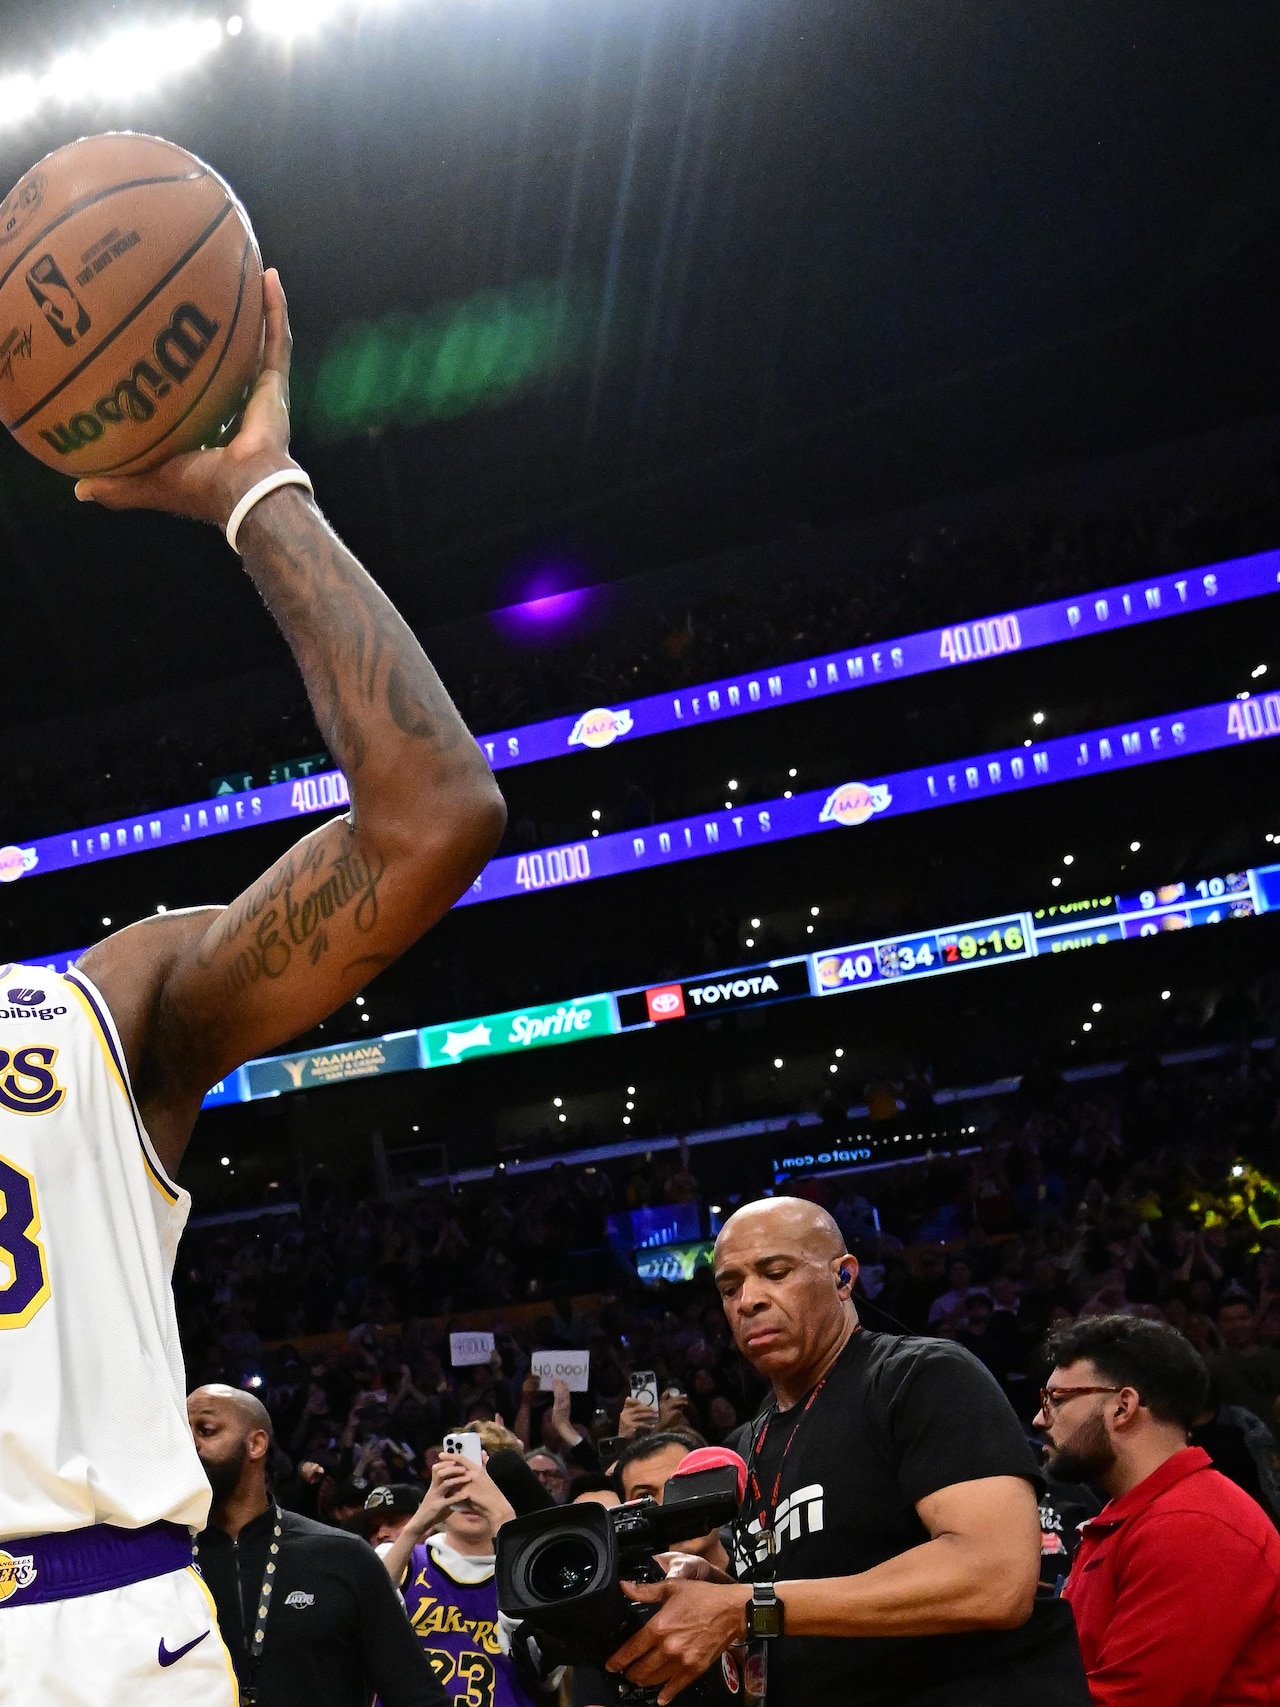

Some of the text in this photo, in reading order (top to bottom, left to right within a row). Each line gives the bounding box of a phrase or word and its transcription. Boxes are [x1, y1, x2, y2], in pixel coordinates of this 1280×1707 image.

[37, 301, 220, 454] Wilson
[807, 647, 903, 687] JAMES
[1067, 574, 1217, 627] POINTS
[1077, 722, 1185, 764] JAMES
[182, 797, 261, 831] JAMES
[633, 811, 770, 857] POINTS
[838, 943, 935, 980] 40 34
[945, 926, 1023, 961] 2 9:16
[687, 974, 779, 1006] TOYOTA
[508, 1006, 593, 1047] Sprite
